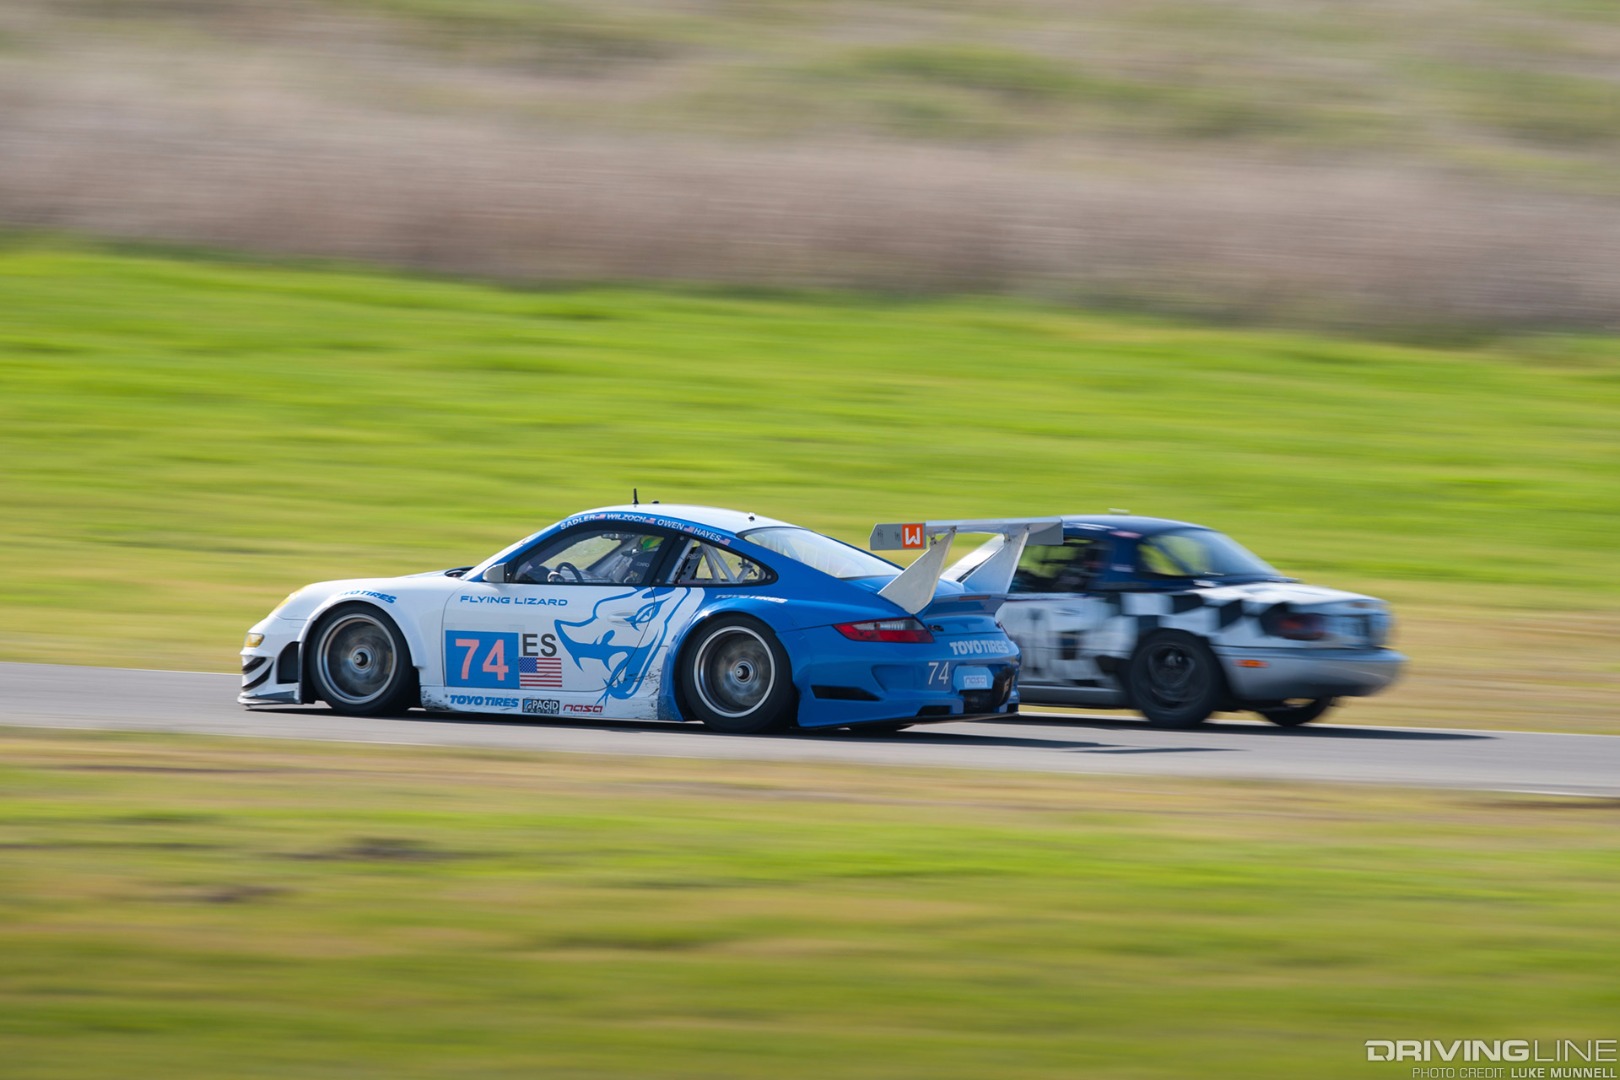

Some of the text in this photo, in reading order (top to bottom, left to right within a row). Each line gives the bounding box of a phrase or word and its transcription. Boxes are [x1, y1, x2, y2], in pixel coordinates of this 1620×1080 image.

[560, 513, 721, 542] SADLER WILZOCH OWEN HAYES
[460, 595, 568, 606] FLYING LIZARD
[522, 633, 557, 657] ES
[455, 638, 509, 681] 74
[928, 662, 949, 685] 74
[532, 700, 559, 710] PAGID
